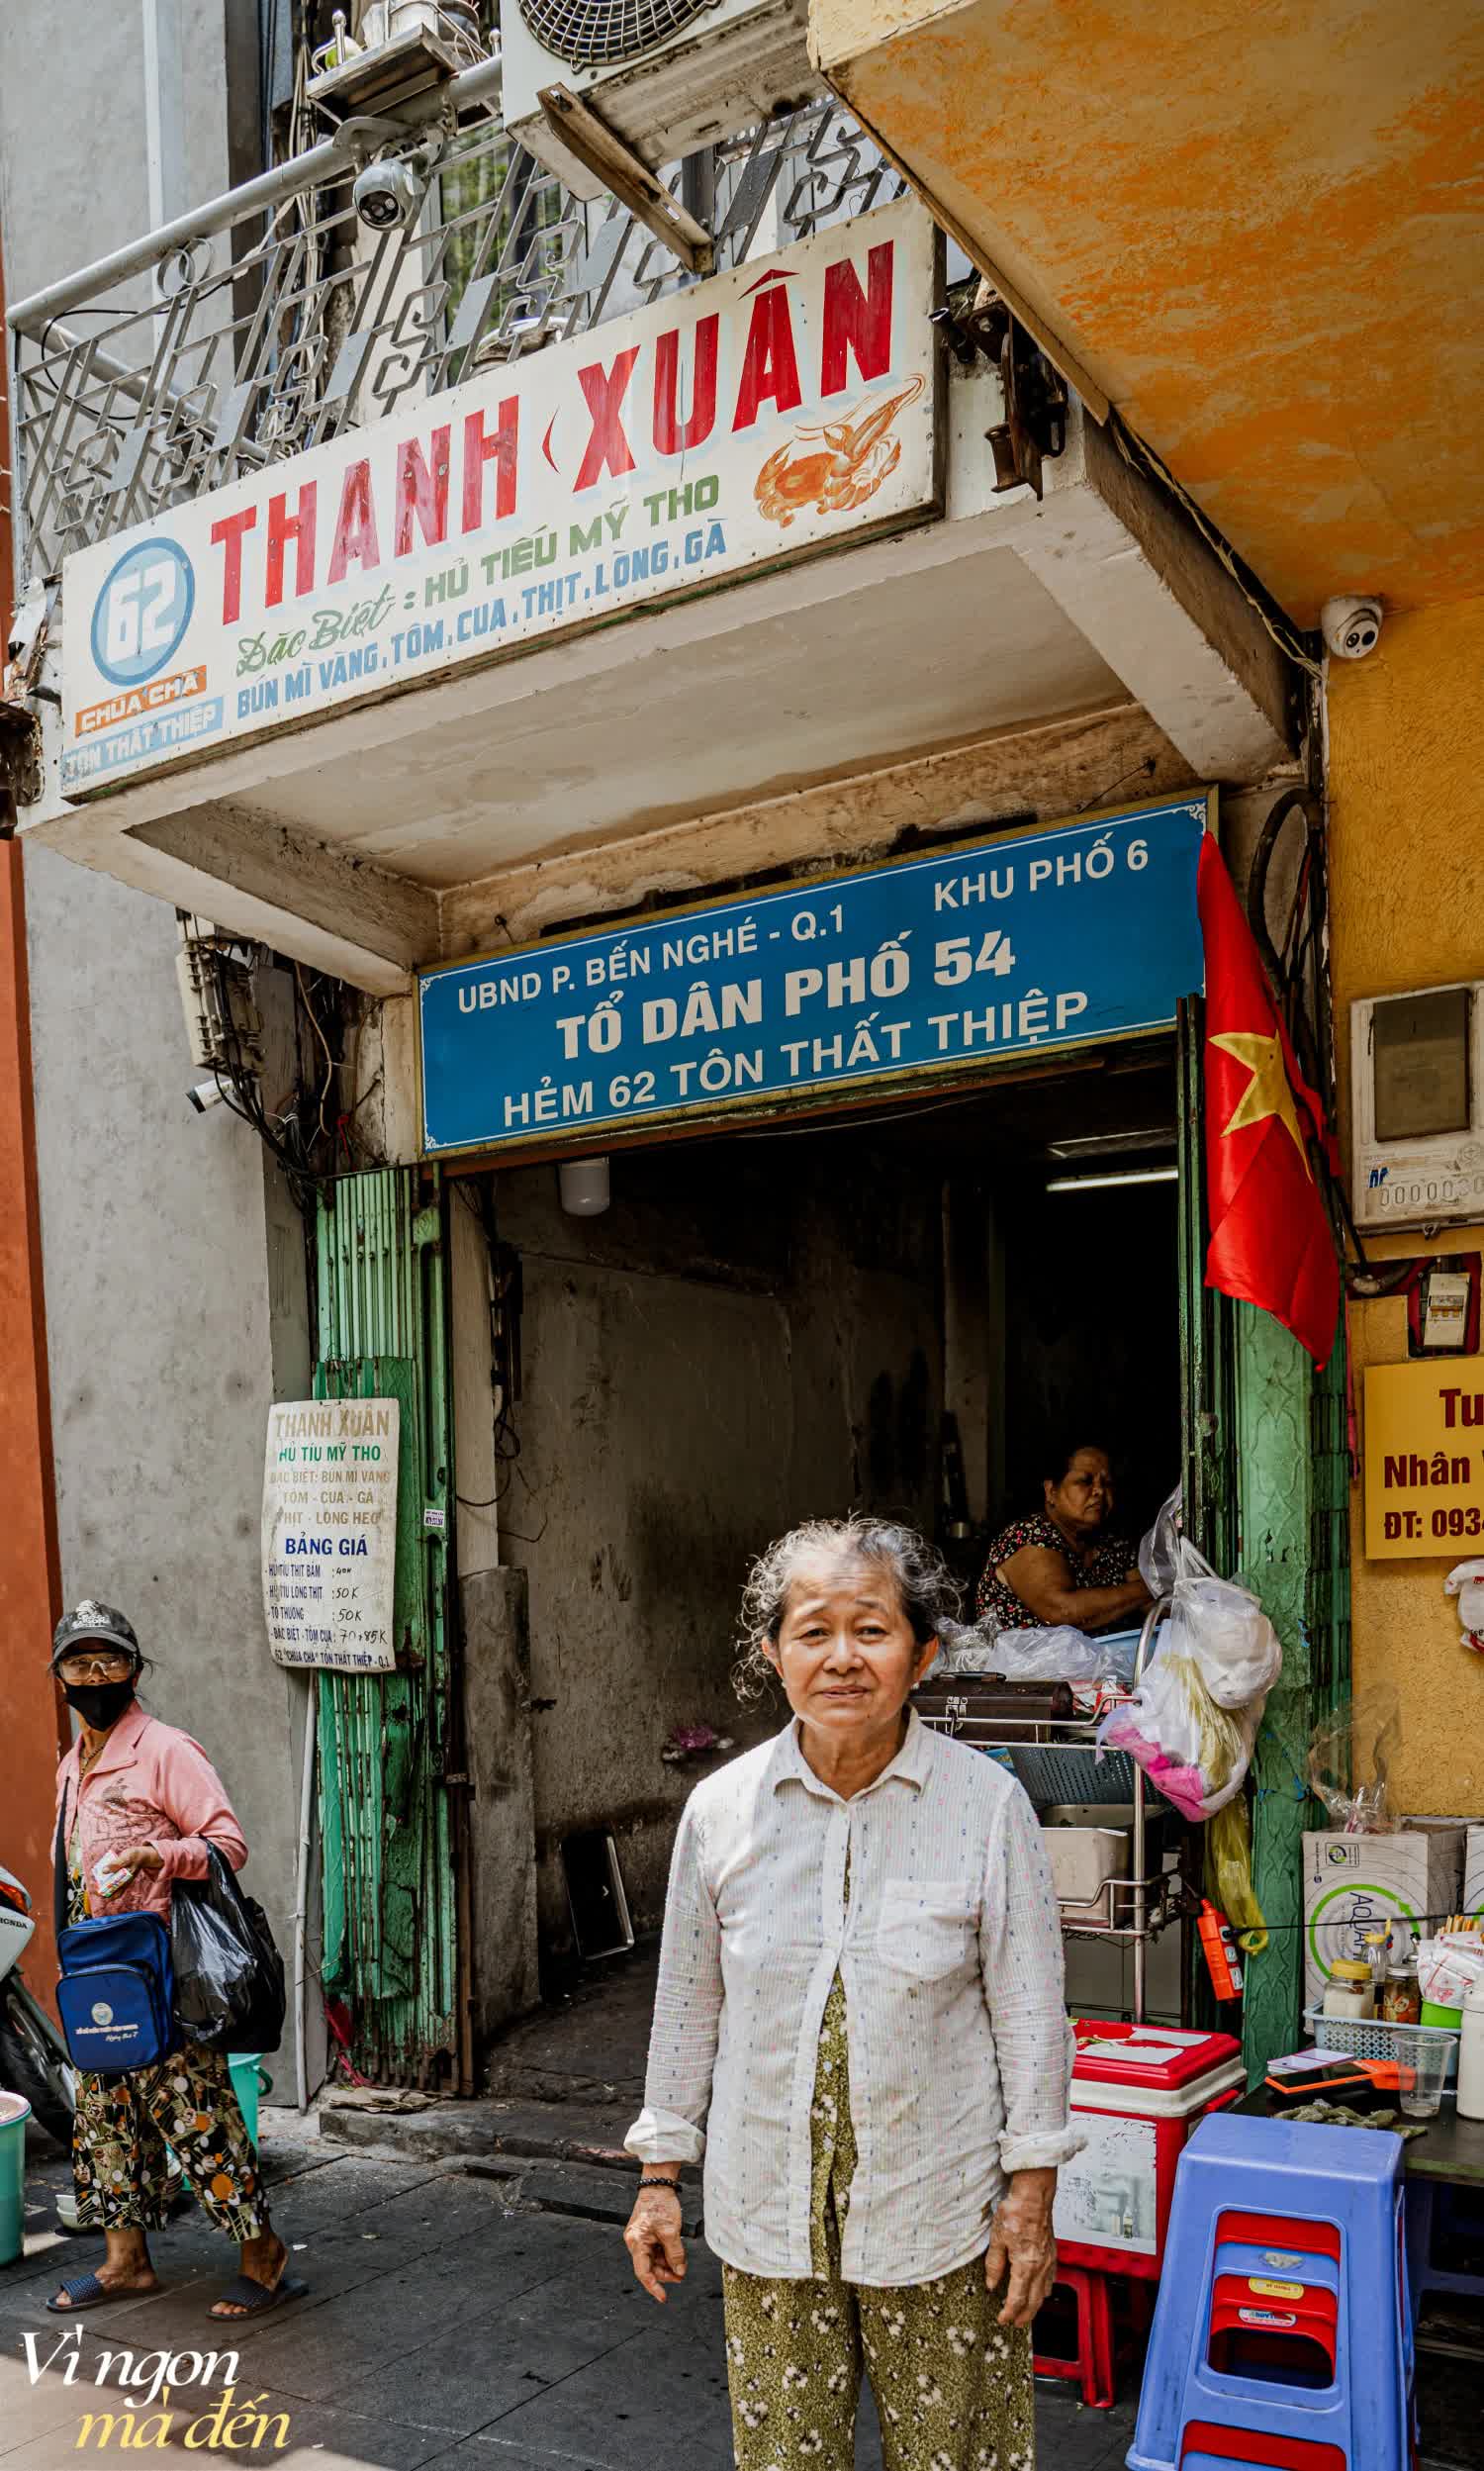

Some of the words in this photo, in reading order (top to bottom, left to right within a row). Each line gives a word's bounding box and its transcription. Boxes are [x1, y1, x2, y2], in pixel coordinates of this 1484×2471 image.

[211, 395, 519, 626] THANH
[573, 239, 894, 494] XUÂN
[425, 557, 469, 608] HỦ
[481, 523, 557, 586] TIẾU
[570, 499, 630, 557] MỸ
[643, 474, 719, 526] THO
[106, 559, 178, 665] 62
[237, 674, 279, 719] BÚN
[285, 662, 312, 703] MÌ
[685, 518, 728, 565] GÀ
[935, 867, 1014, 911] KHU
[1029, 830, 1115, 892] PHỐ
[1126, 839, 1149, 871] 6
[458, 973, 541, 1013] UBND
[552, 966, 576, 994] P.
[586, 940, 650, 987] BẾN
[663, 917, 758, 971] NGHÉ
[791, 904, 844, 941] Q.1
[556, 991, 622, 1060] TỔ
[642, 979, 763, 1045] DÂN
[786, 928, 912, 1016] PHỐ
[934, 930, 1016, 987] 54
[504, 1076, 594, 1128] HẺM
[608, 1072, 656, 1108] 62
[670, 1047, 763, 1097] TÔN
[780, 1012, 911, 1077] THẤT
[928, 988, 1088, 1052] THIỆP
[276, 1410, 331, 1437] THANH
[338, 1402, 390, 1437] XUÂN
[327, 1442, 346, 1462] MỸ
[352, 1445, 381, 1462] THO
[321, 1490, 344, 1504] CUA
[1384, 1451, 1470, 1488] Nhân
[285, 1532, 332, 1556] BẢNG
[338, 1535, 368, 1556] GIÁ
[1384, 1511, 1422, 1540] ĐT:
[1432, 1507, 1484, 1539] 093
